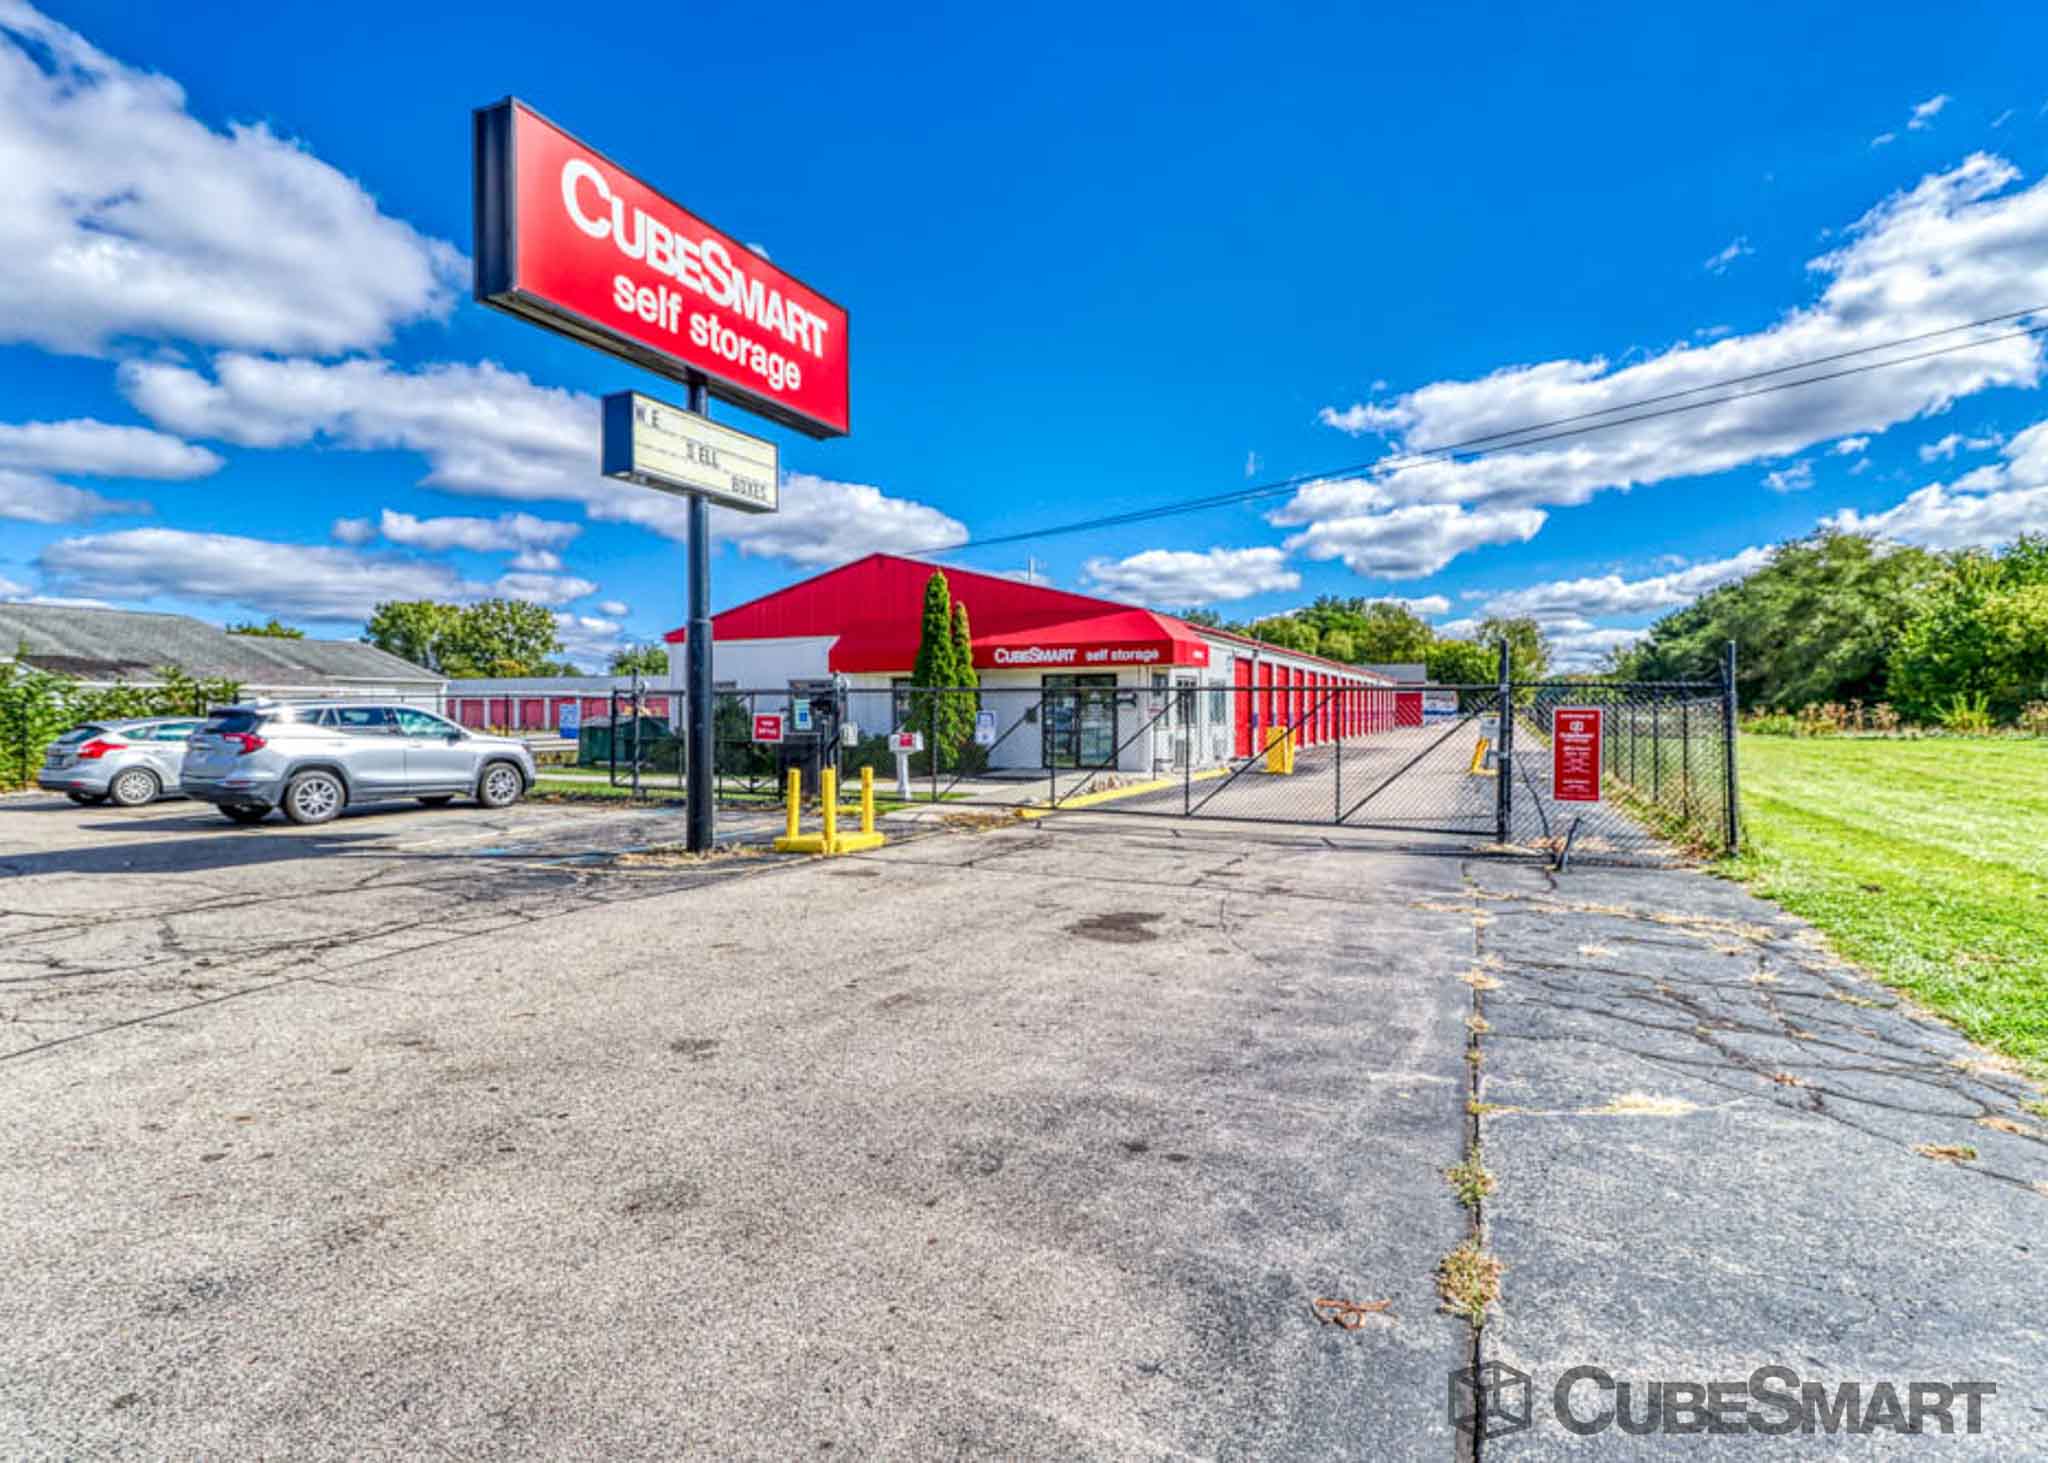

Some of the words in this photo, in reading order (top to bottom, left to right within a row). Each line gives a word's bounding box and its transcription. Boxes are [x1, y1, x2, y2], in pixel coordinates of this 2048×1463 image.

[613, 275, 683, 334] self
[689, 312, 801, 390] storage
[1084, 649, 1108, 661] self
[1110, 648, 1160, 663] storage
